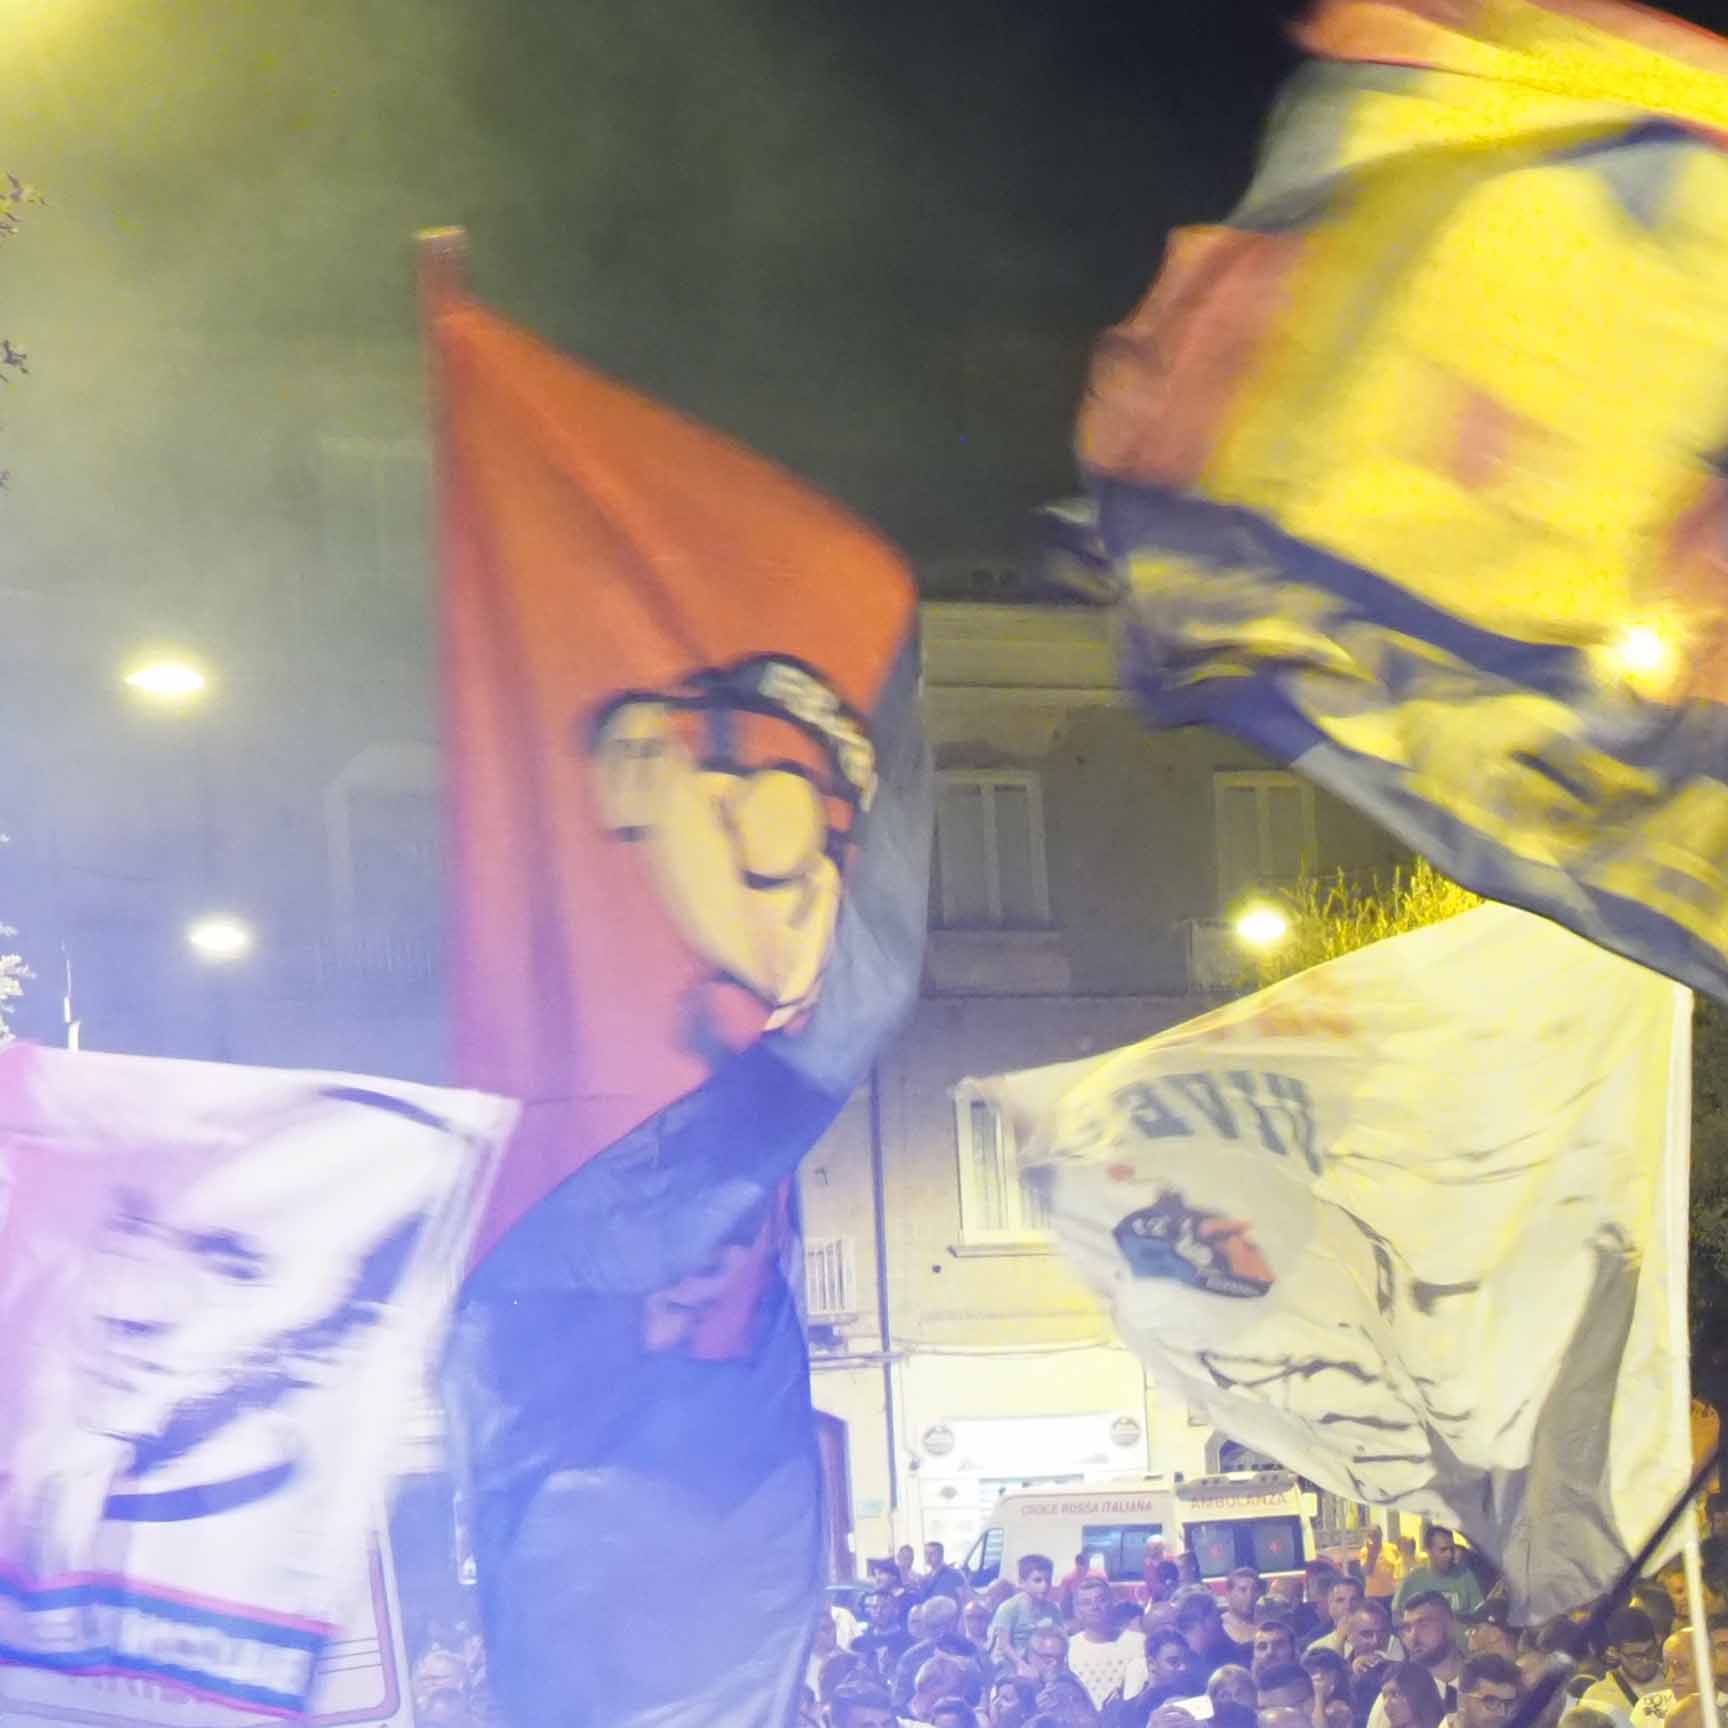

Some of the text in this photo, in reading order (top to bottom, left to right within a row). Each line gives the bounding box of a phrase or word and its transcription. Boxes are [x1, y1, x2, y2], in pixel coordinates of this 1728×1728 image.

[1061, 1501, 1099, 1513] ROSSA
[1102, 1499, 1152, 1513] ITALIANA
[1191, 1492, 1288, 1510] AMBULANZA
